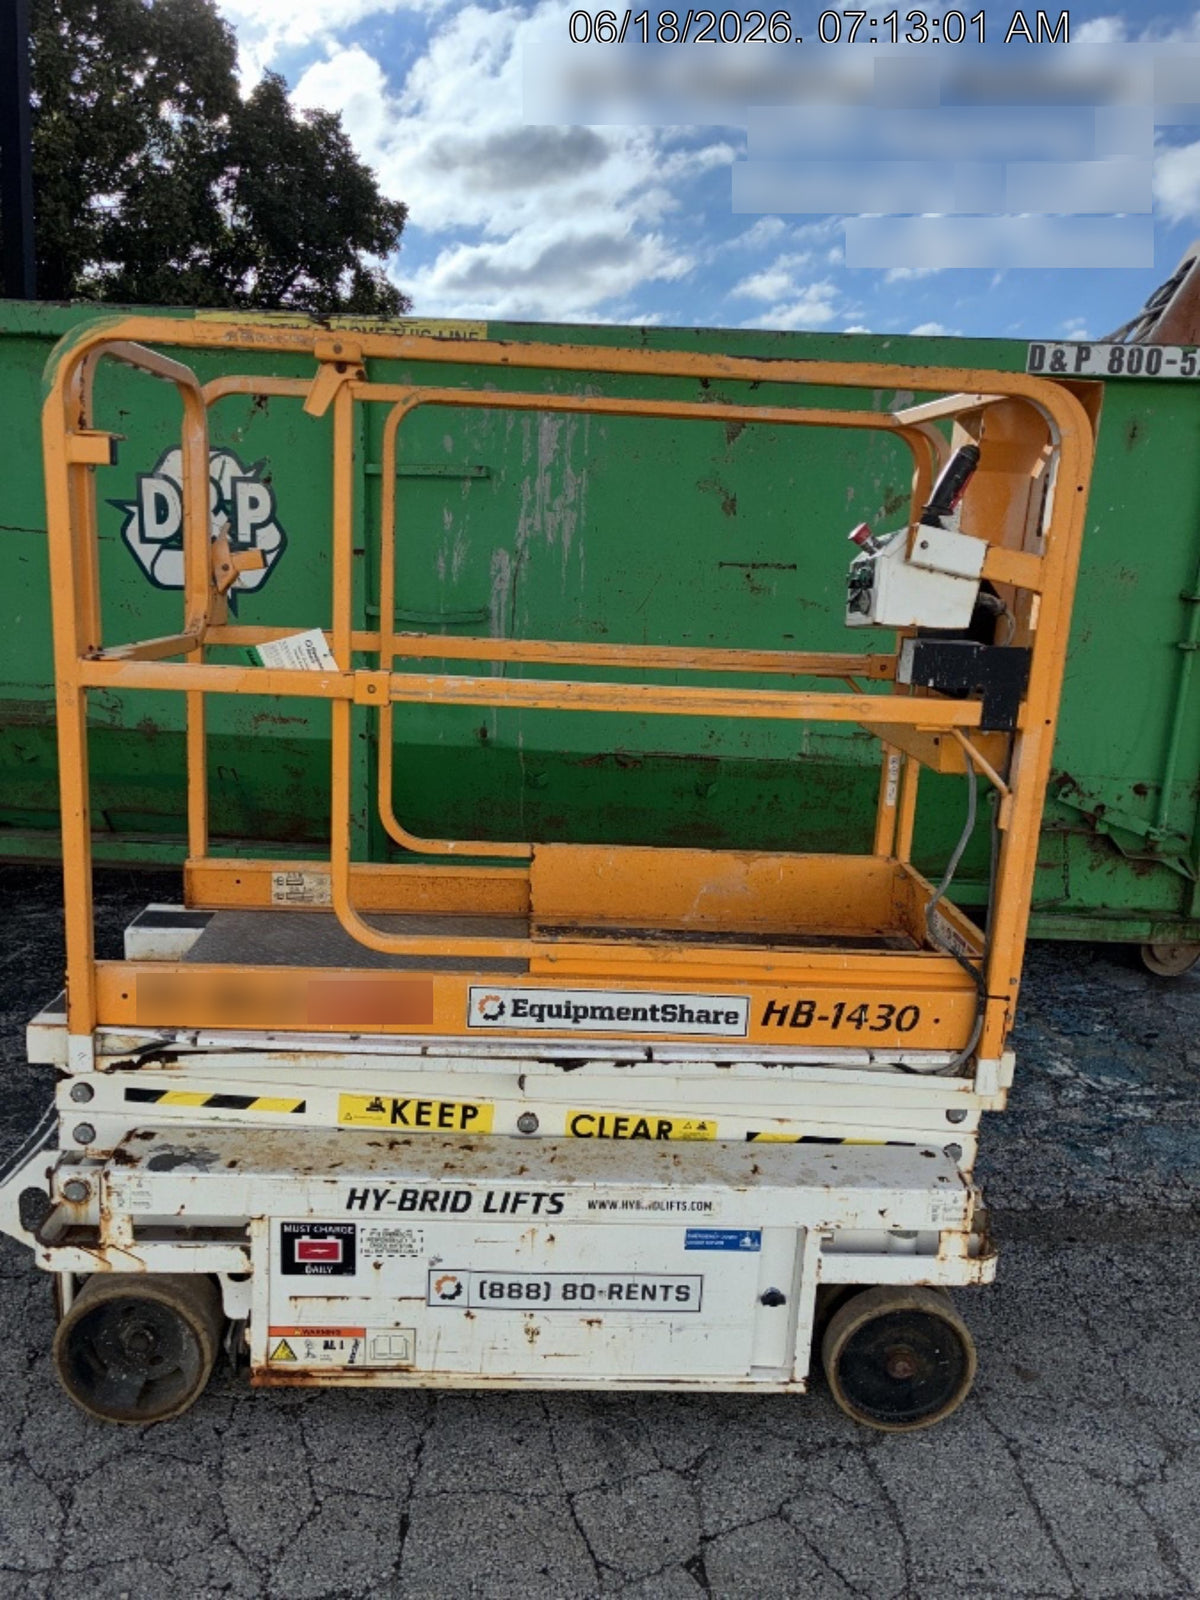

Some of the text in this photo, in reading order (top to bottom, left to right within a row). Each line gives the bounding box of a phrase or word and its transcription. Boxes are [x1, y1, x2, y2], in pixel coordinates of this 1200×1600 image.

[1107, 345, 1200, 376] 800-5
[511, 998, 739, 1027] EquipmentShare
[761, 1000, 920, 1032] HB-1430
[390, 1098, 673, 1140] KEEP CLEAR
[346, 1187, 565, 1214] HY-BRID LIFTS
[284, 1224, 311, 1233] MUST
[305, 1264, 333, 1274] DAILY
[478, 1280, 692, 1302] (888) 80-RENTS
